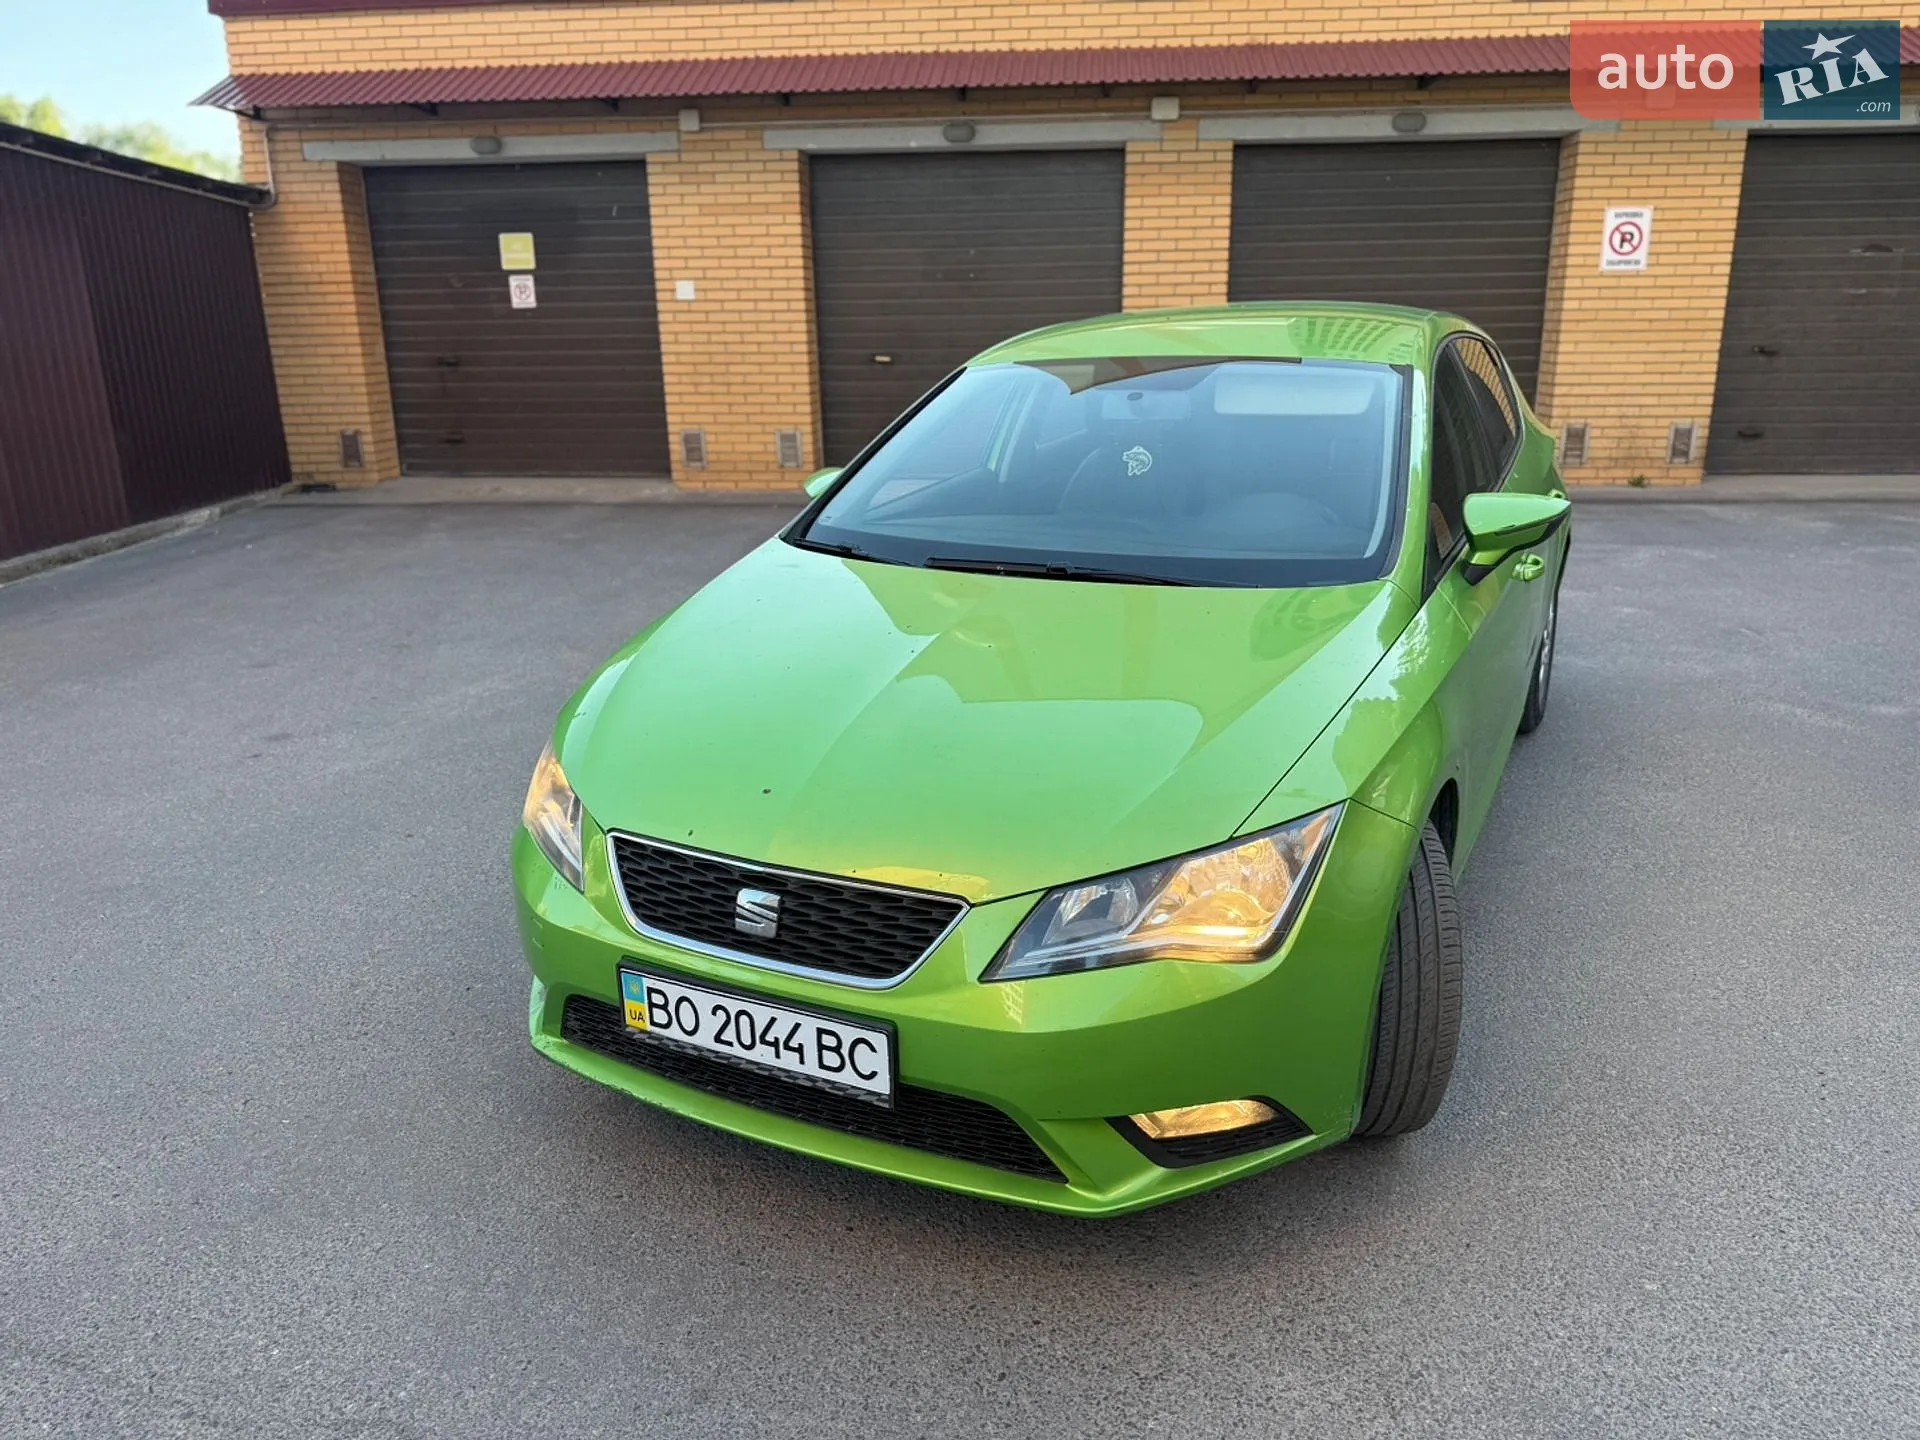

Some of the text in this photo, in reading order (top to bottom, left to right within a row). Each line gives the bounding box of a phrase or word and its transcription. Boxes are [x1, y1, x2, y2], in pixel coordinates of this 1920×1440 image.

[629, 1008, 646, 1024] UA
[646, 986, 878, 1081] BO 2044 BC
